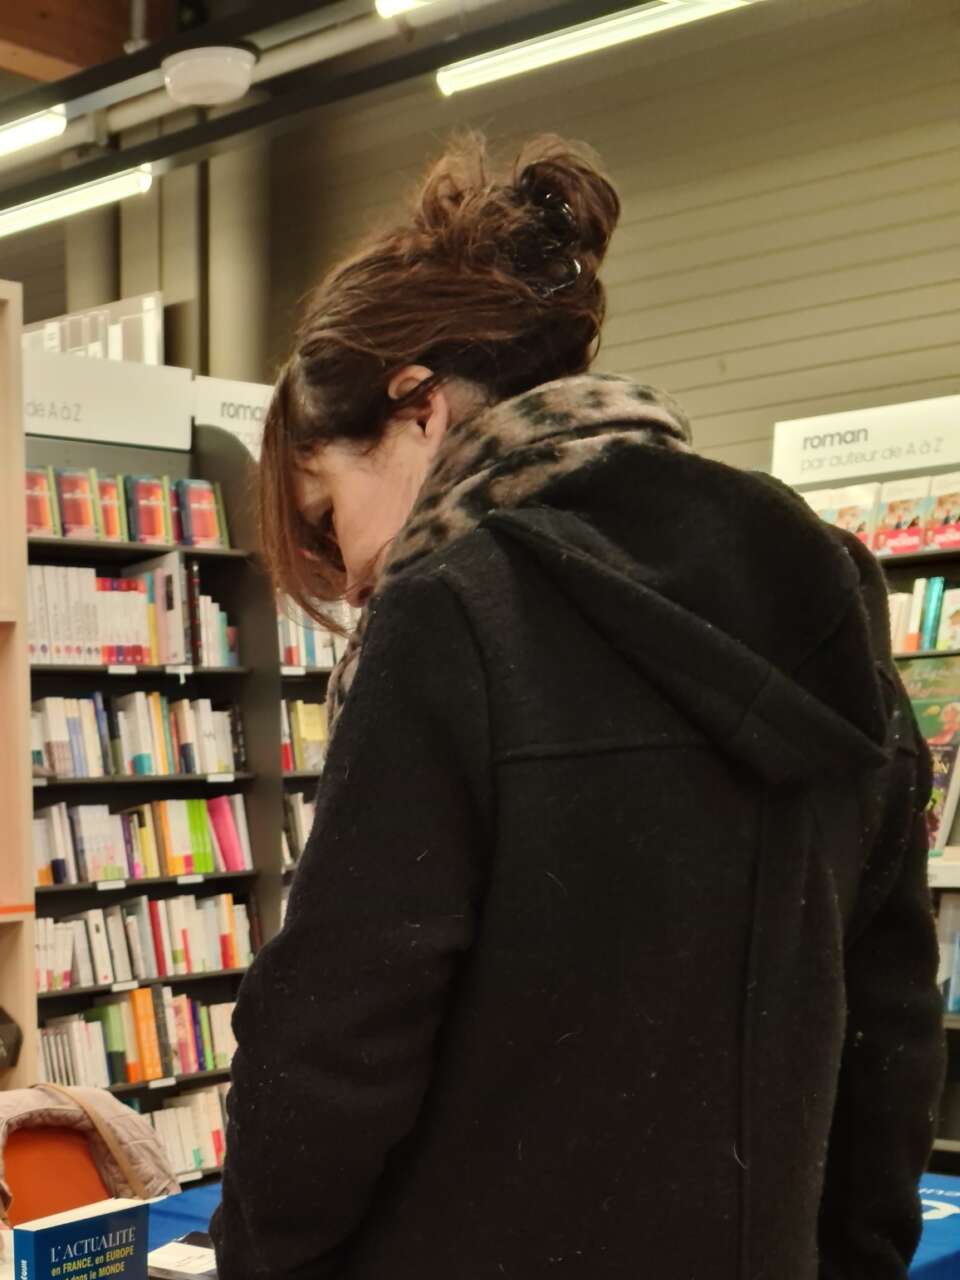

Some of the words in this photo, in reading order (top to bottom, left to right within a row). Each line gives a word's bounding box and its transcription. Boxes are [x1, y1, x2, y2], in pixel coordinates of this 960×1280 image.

[803, 428, 869, 450] roman
[829, 448, 878, 467] auteur
[95, 1256, 104, 1264] en
[106, 1245, 134, 1261] EUROPE
[90, 1270, 97, 1280] le
[99, 1261, 125, 1277] MONDE
